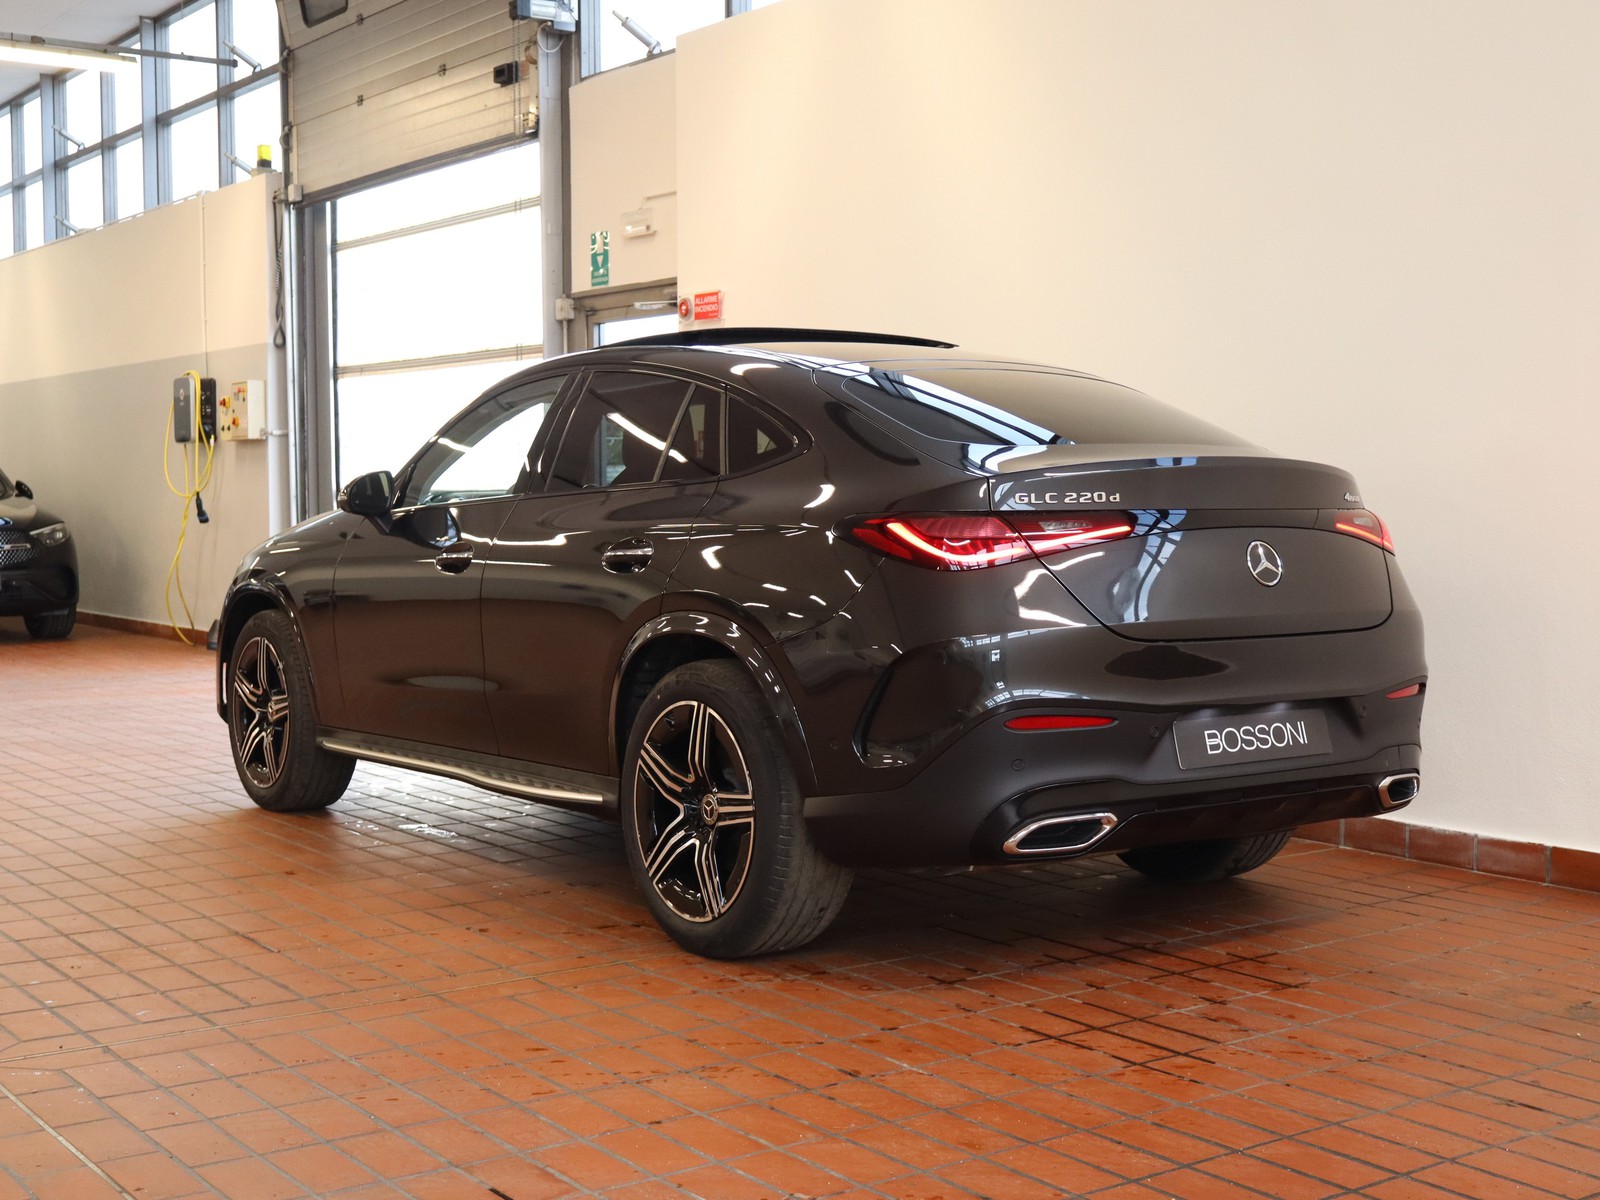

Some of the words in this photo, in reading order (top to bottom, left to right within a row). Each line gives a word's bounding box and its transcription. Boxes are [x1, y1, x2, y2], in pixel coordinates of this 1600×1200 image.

[695, 295, 718, 304] ALLARME
[694, 303, 719, 313] INCENDIO
[1014, 492, 1059, 504] GLC
[1204, 721, 1308, 755] BOSSONI
